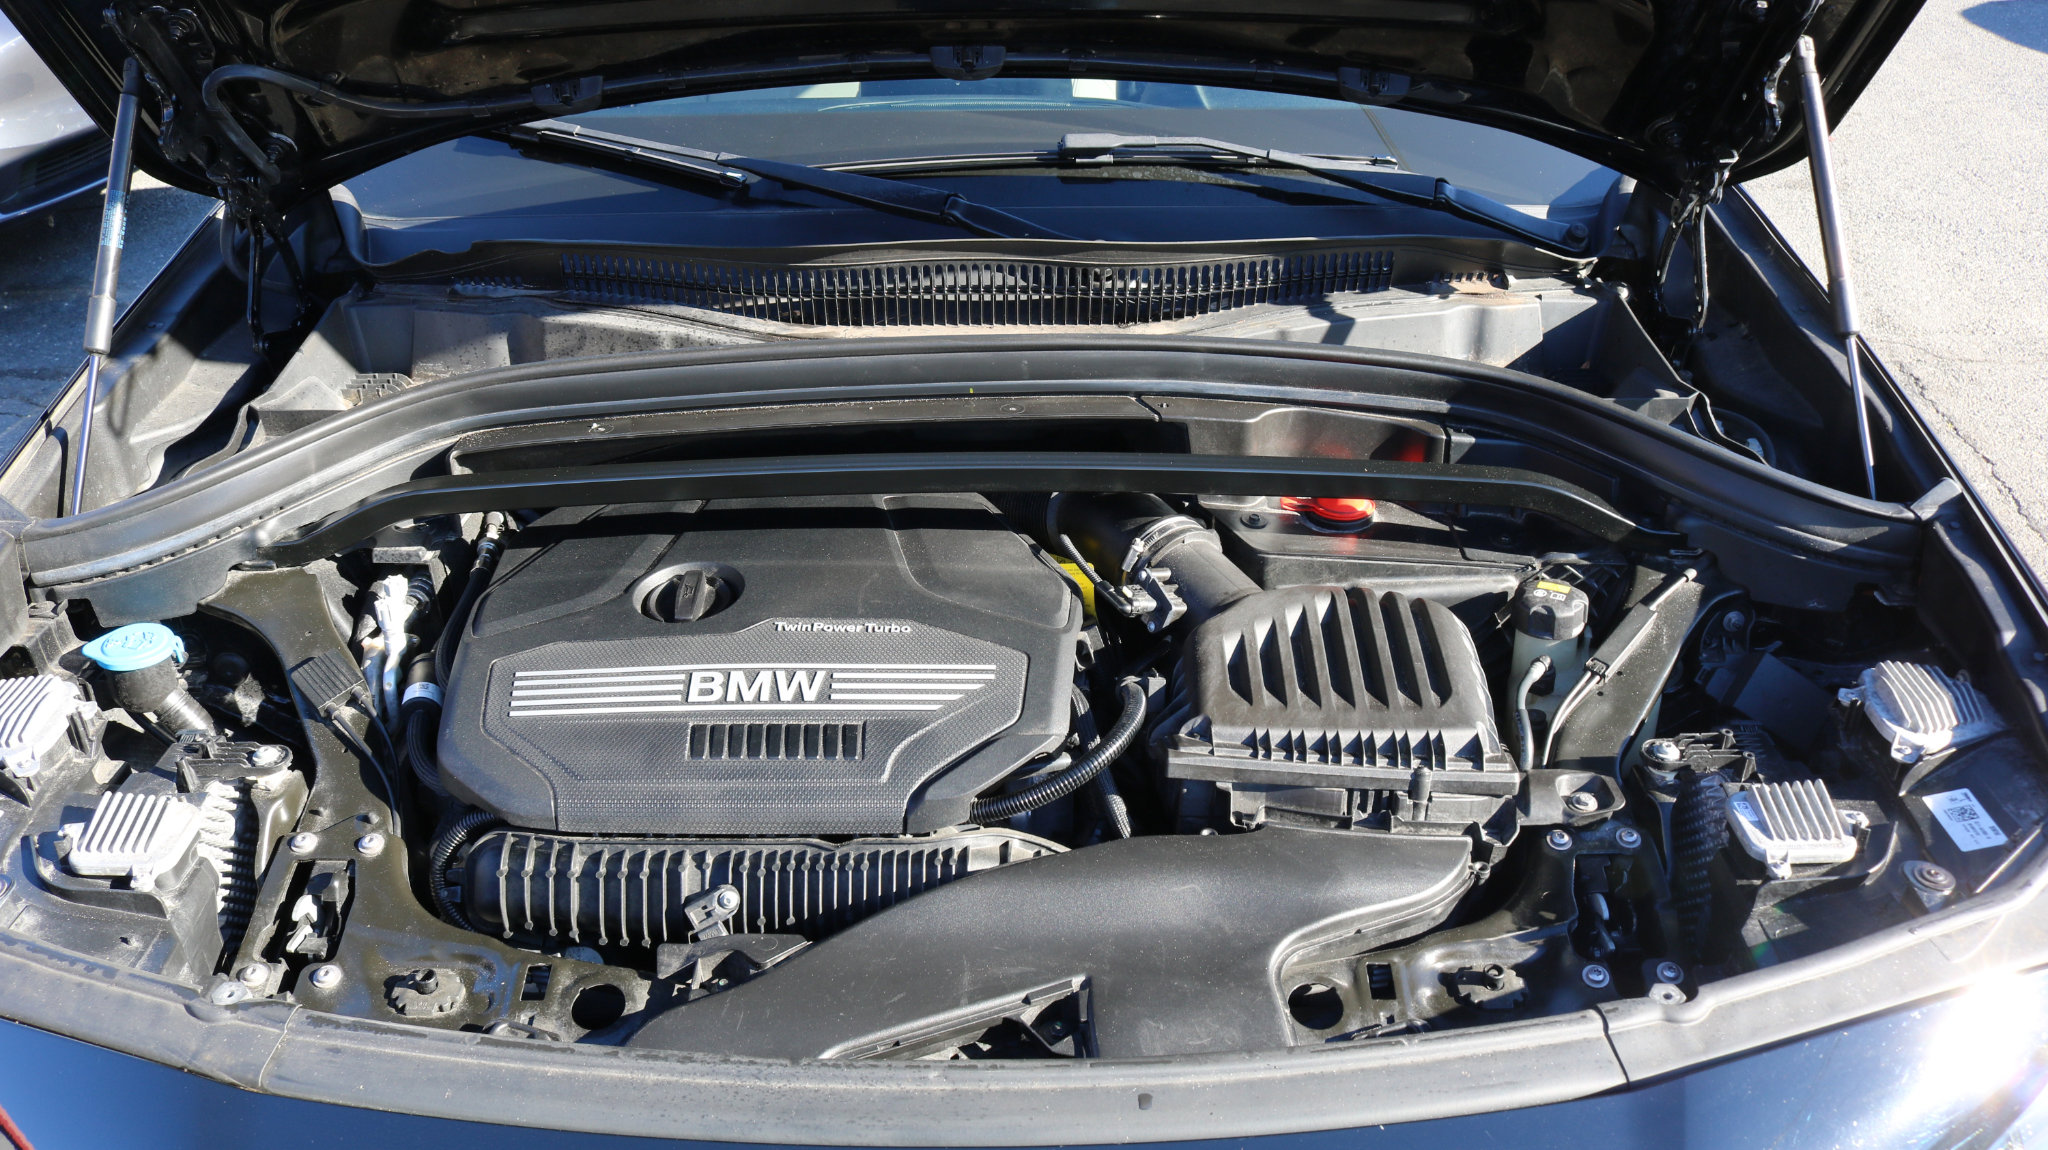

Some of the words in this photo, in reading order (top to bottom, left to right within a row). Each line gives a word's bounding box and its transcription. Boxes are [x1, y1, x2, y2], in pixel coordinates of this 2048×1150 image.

[774, 621, 863, 633] TwinPower
[864, 622, 912, 633] Turbo
[686, 670, 827, 703] BMW
